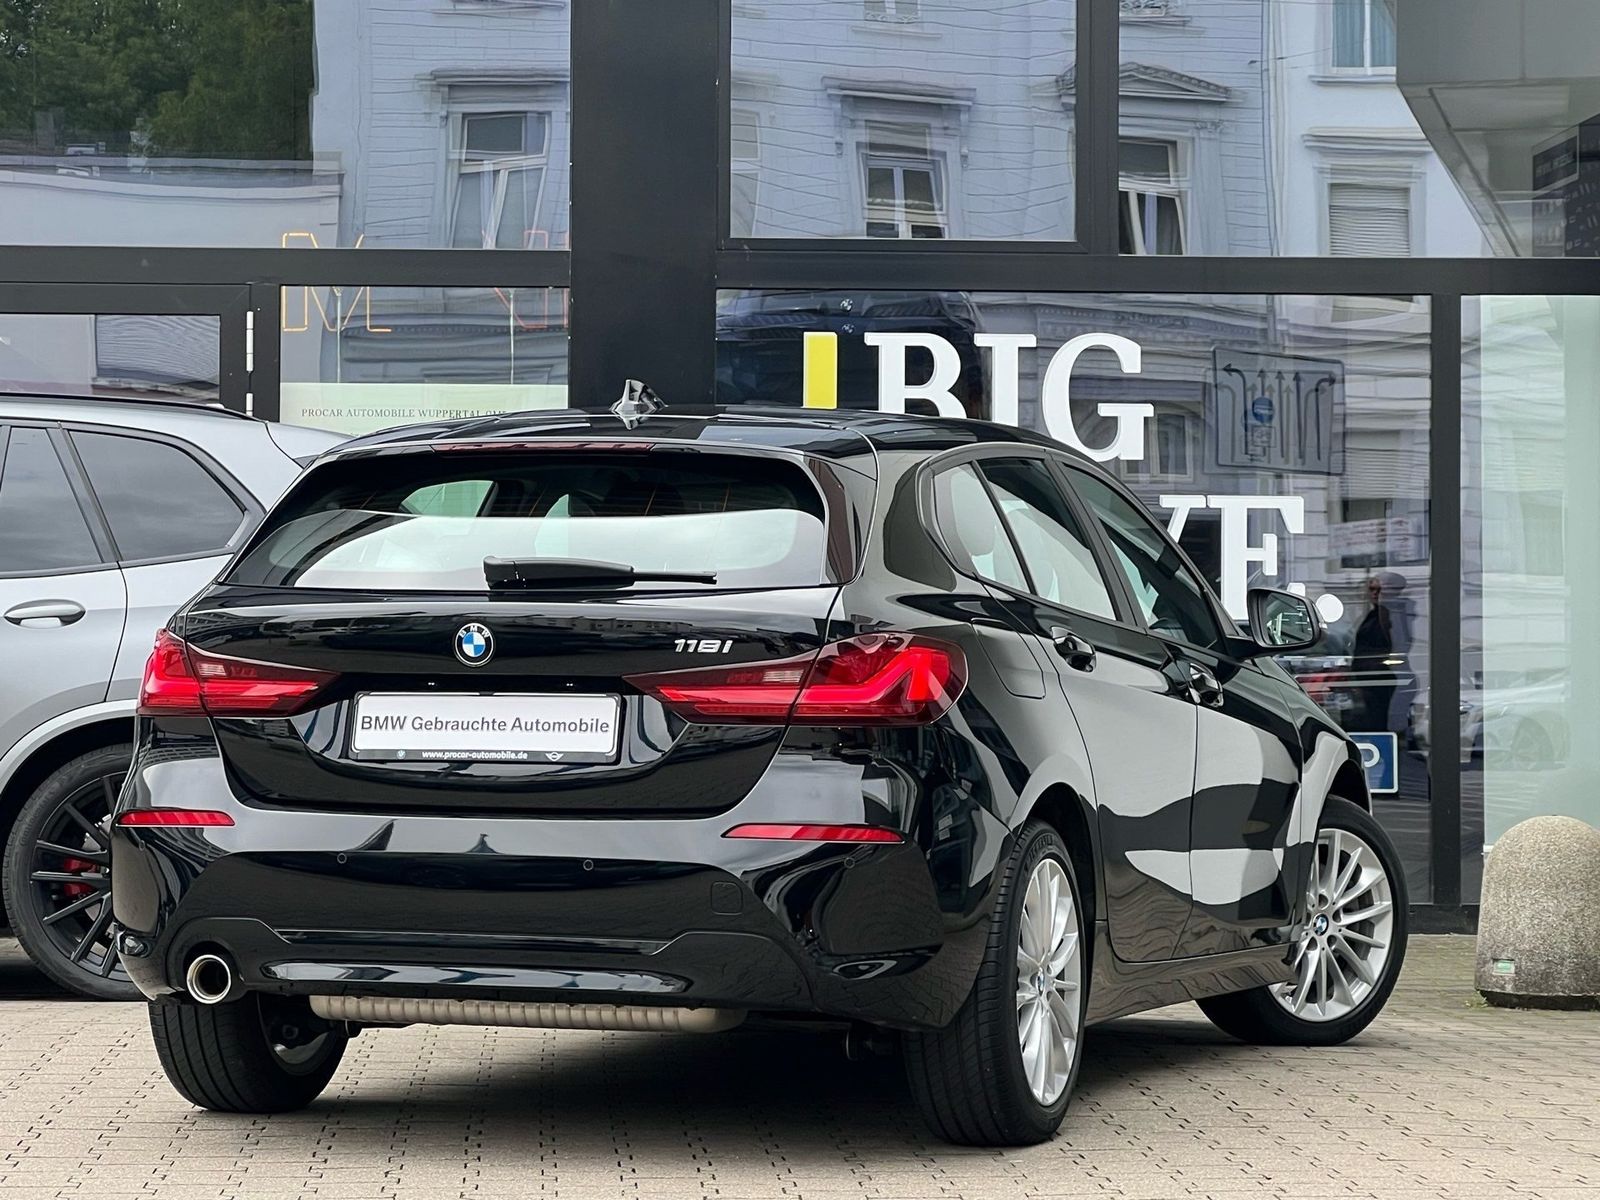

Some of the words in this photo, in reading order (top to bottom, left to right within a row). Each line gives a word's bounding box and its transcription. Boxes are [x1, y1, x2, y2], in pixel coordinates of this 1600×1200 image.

[863, 331, 1155, 462] BIG
[301, 408, 343, 418] PROCAR
[346, 408, 415, 418] AUTOMOBILE
[418, 409, 481, 419] WUPPERTAL
[458, 625, 491, 639] BMW
[360, 715, 408, 731] BMW
[410, 716, 507, 732] Gebrauchte
[510, 717, 610, 733] Automobile
[421, 750, 529, 760] www.procar-automobile.de
